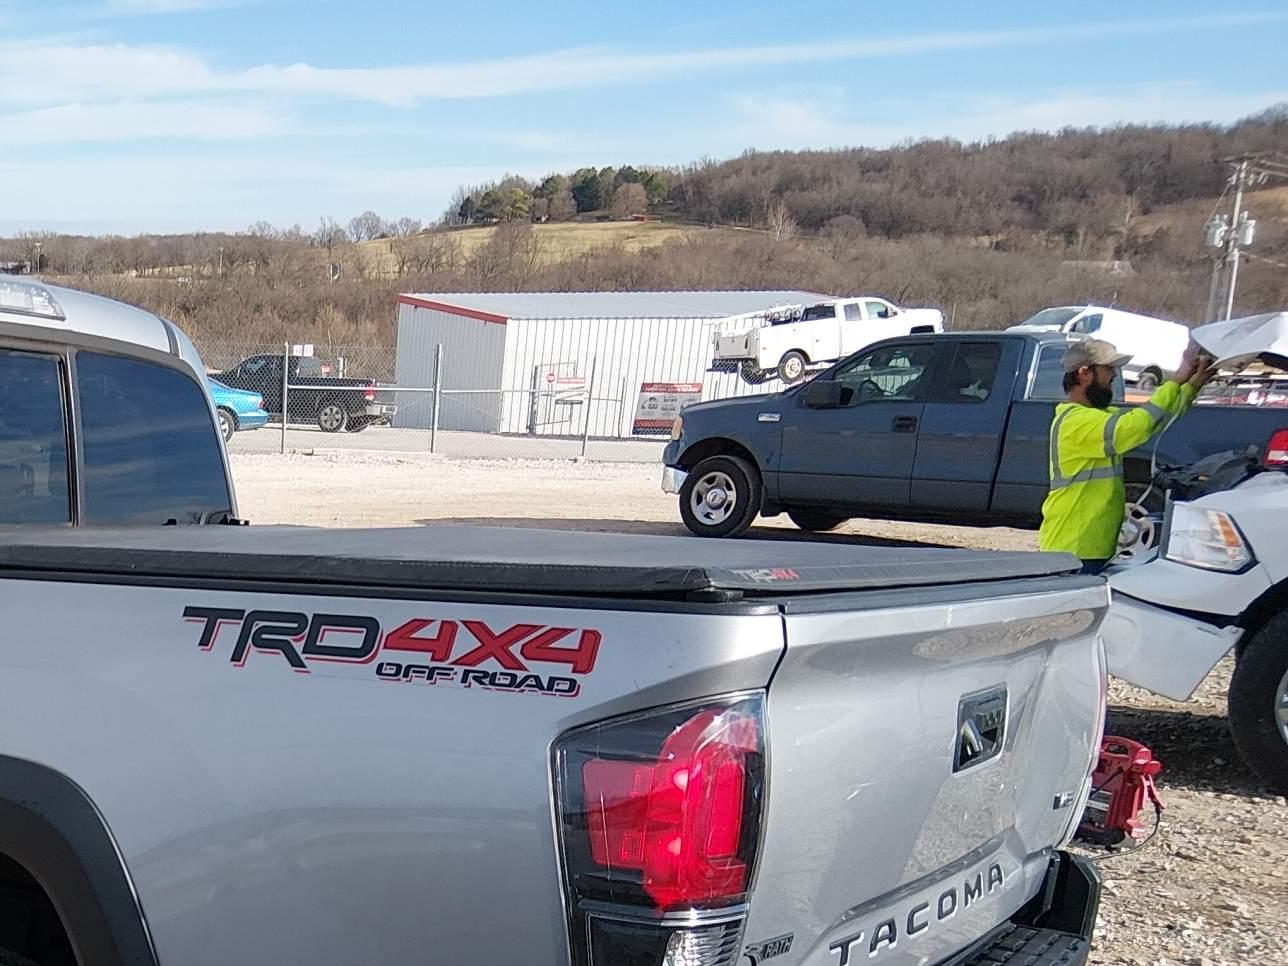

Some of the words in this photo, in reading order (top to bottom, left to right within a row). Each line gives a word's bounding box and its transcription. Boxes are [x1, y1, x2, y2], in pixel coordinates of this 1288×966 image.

[182, 605, 383, 672] TRD
[375, 662, 456, 682] OFF
[459, 668, 580, 698] ROAD
